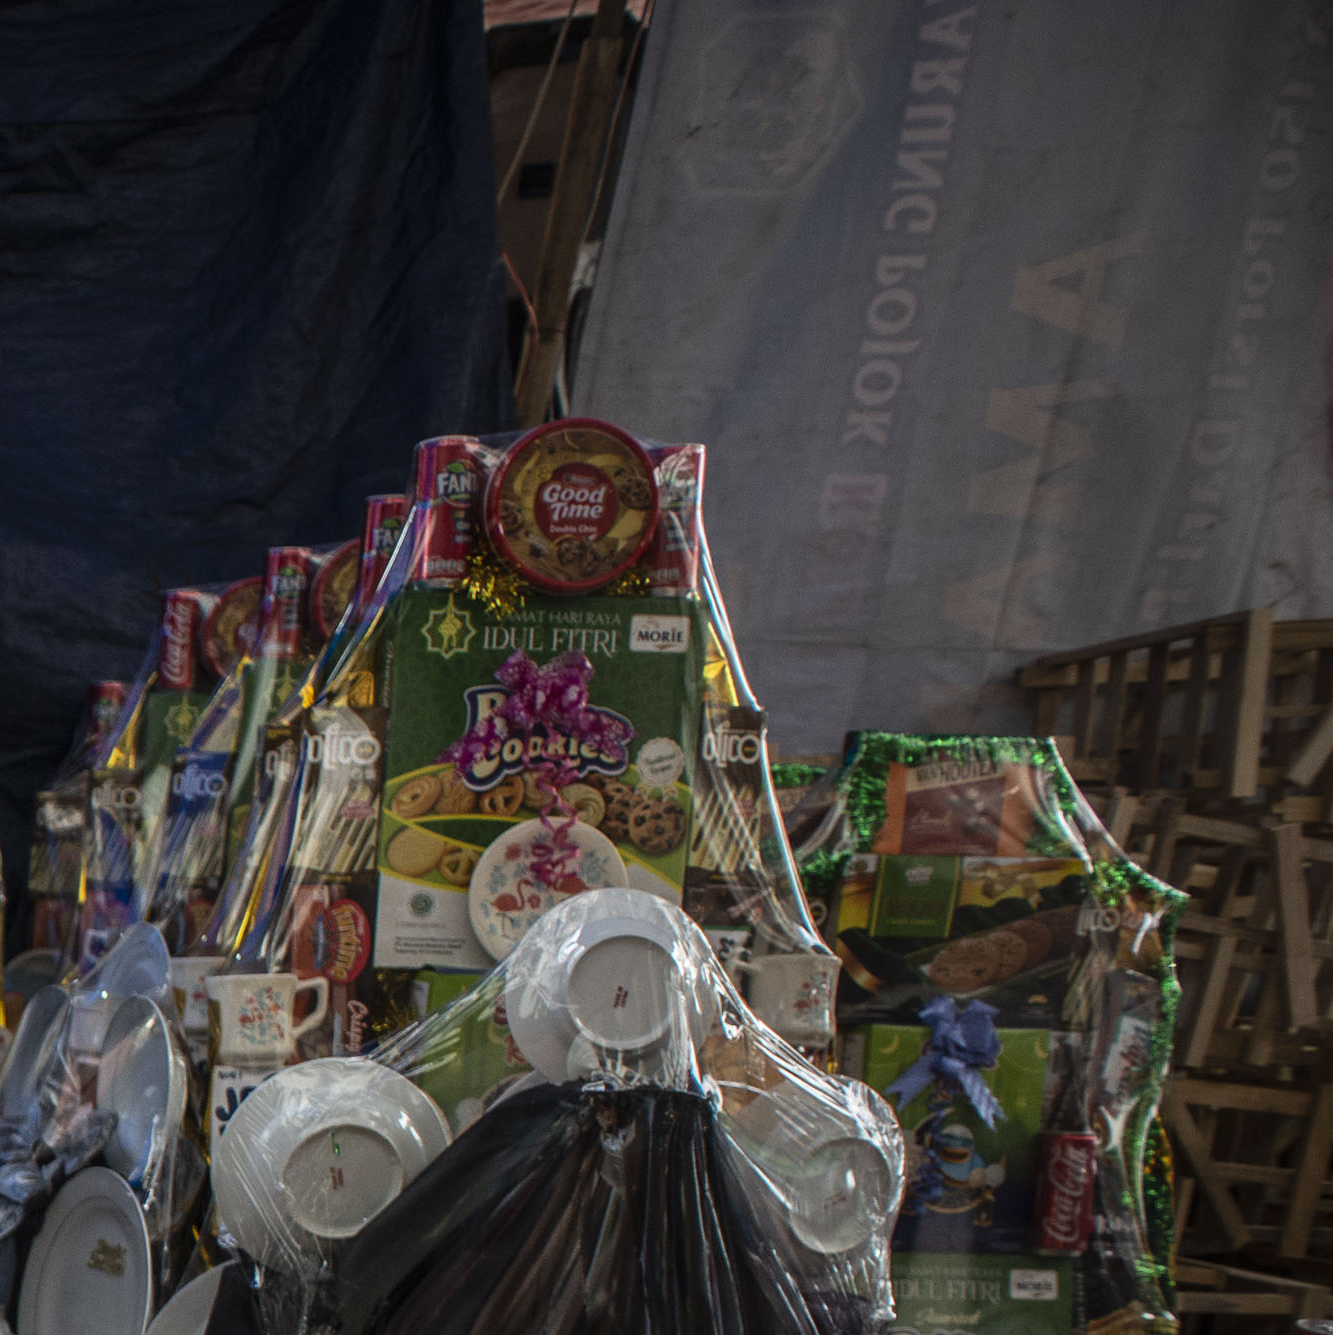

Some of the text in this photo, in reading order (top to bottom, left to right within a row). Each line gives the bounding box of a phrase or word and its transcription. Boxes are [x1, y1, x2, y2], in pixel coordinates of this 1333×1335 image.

[438, 472, 477, 494] FAN
[543, 484, 606, 503] Good
[549, 502, 603, 522] Time
[550, 610, 621, 625] HARI RAYA
[483, 626, 619, 657] IDUL FITRI
[637, 629, 683, 642] MORIE
